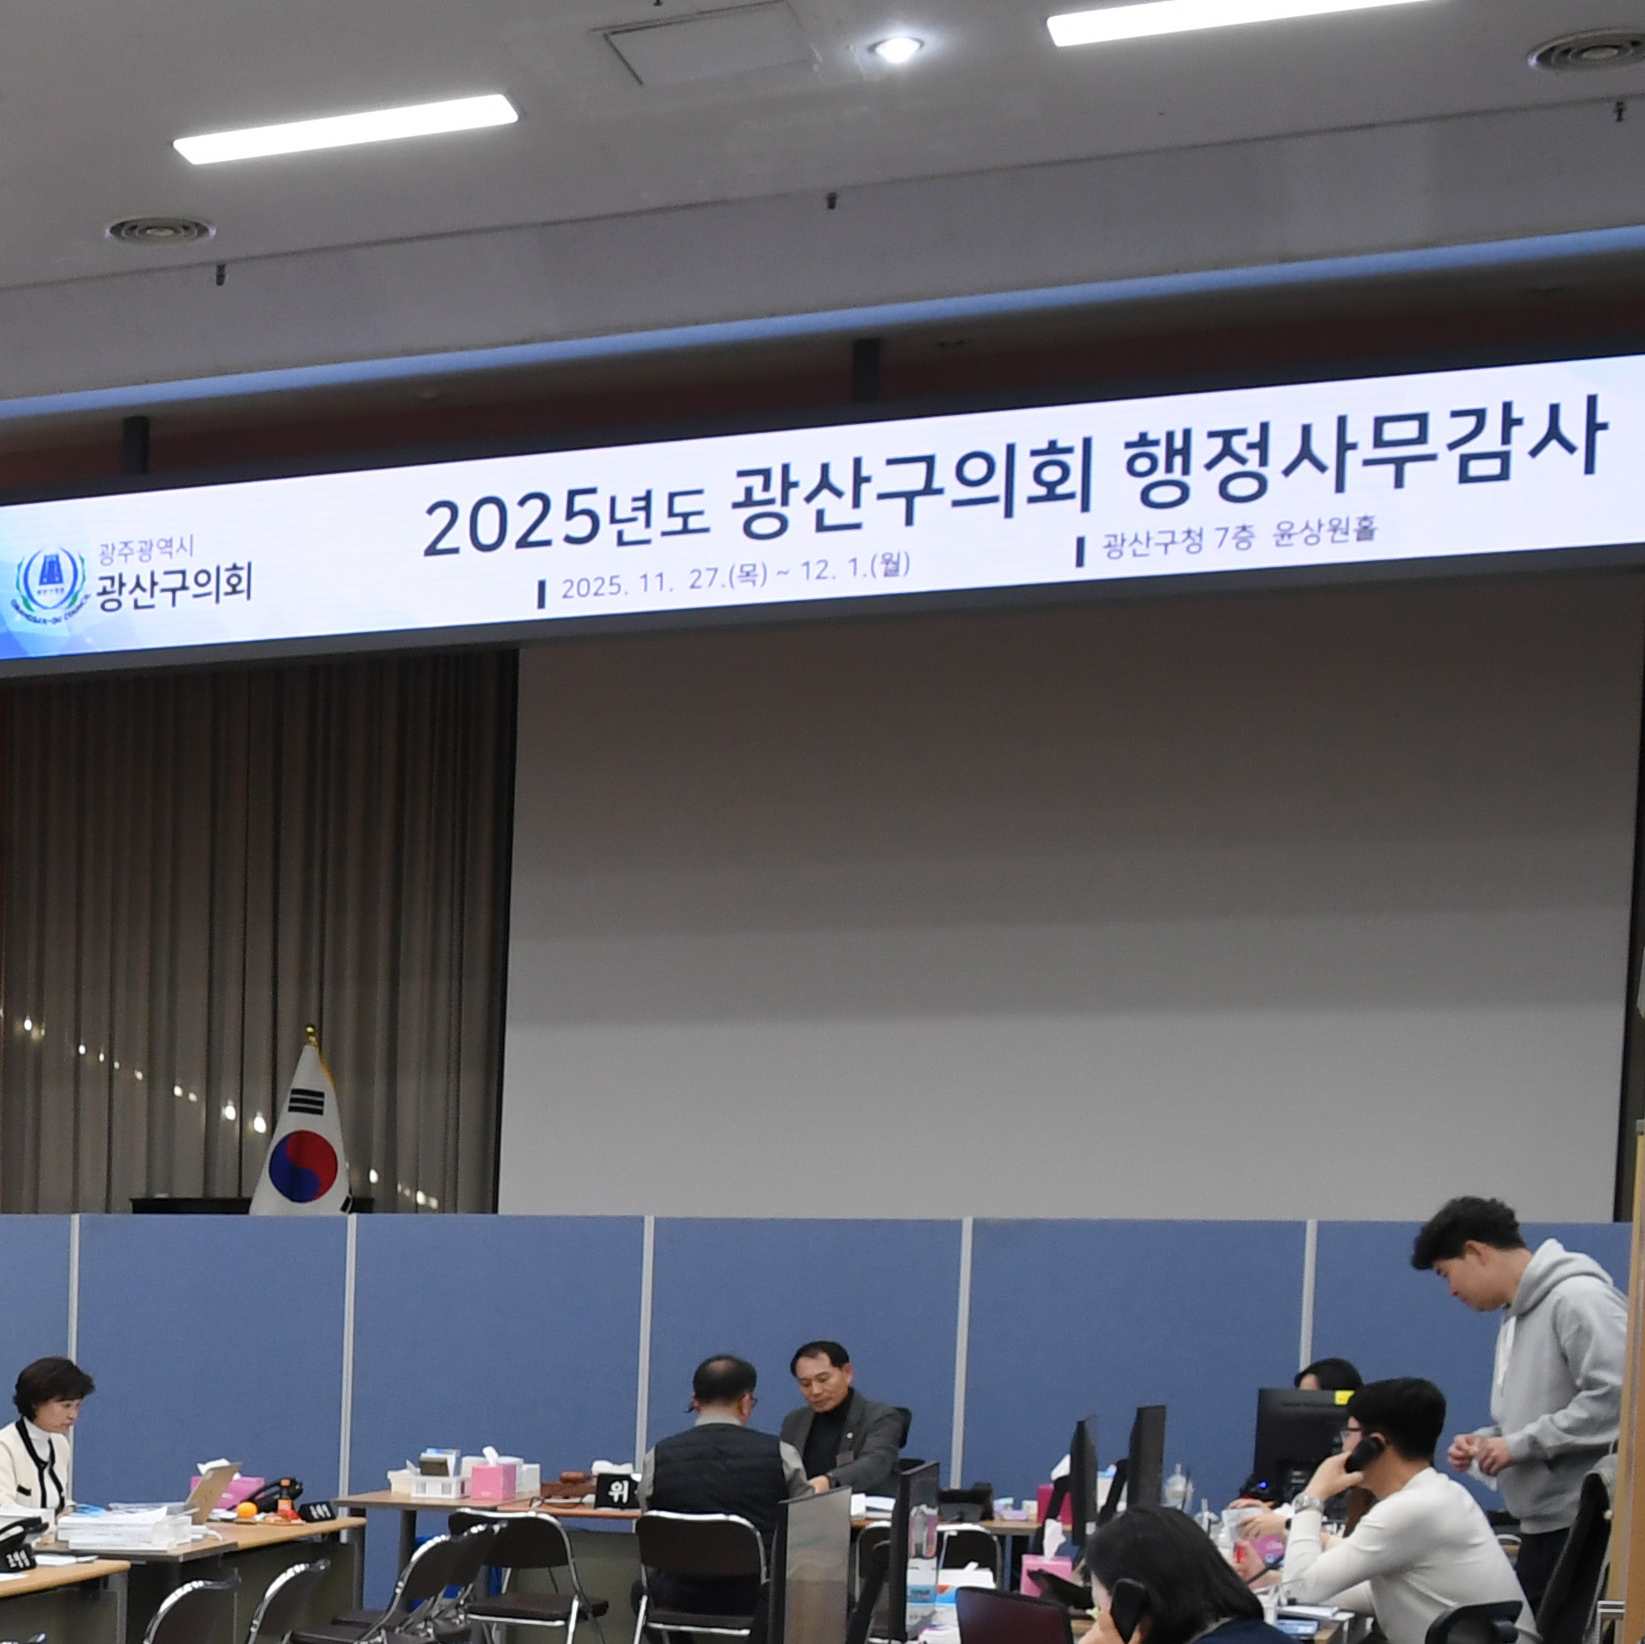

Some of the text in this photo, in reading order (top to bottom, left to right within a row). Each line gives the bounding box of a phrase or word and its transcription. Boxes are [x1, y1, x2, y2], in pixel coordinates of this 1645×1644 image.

[423, 393, 1610, 557] 2025년도 광산구의회 행정사무감사
[98, 534, 195, 566] 광주광역시
[1103, 514, 1378, 560] 광산구청 7층 윤상원홀
[96, 561, 252, 612] 광산구의회
[562, 575, 628, 599] 2025.
[639, 572, 674, 593] 11.
[689, 562, 768, 590] 27.(목)
[801, 559, 836, 581] 12.
[848, 551, 911, 579] 1.(월)
